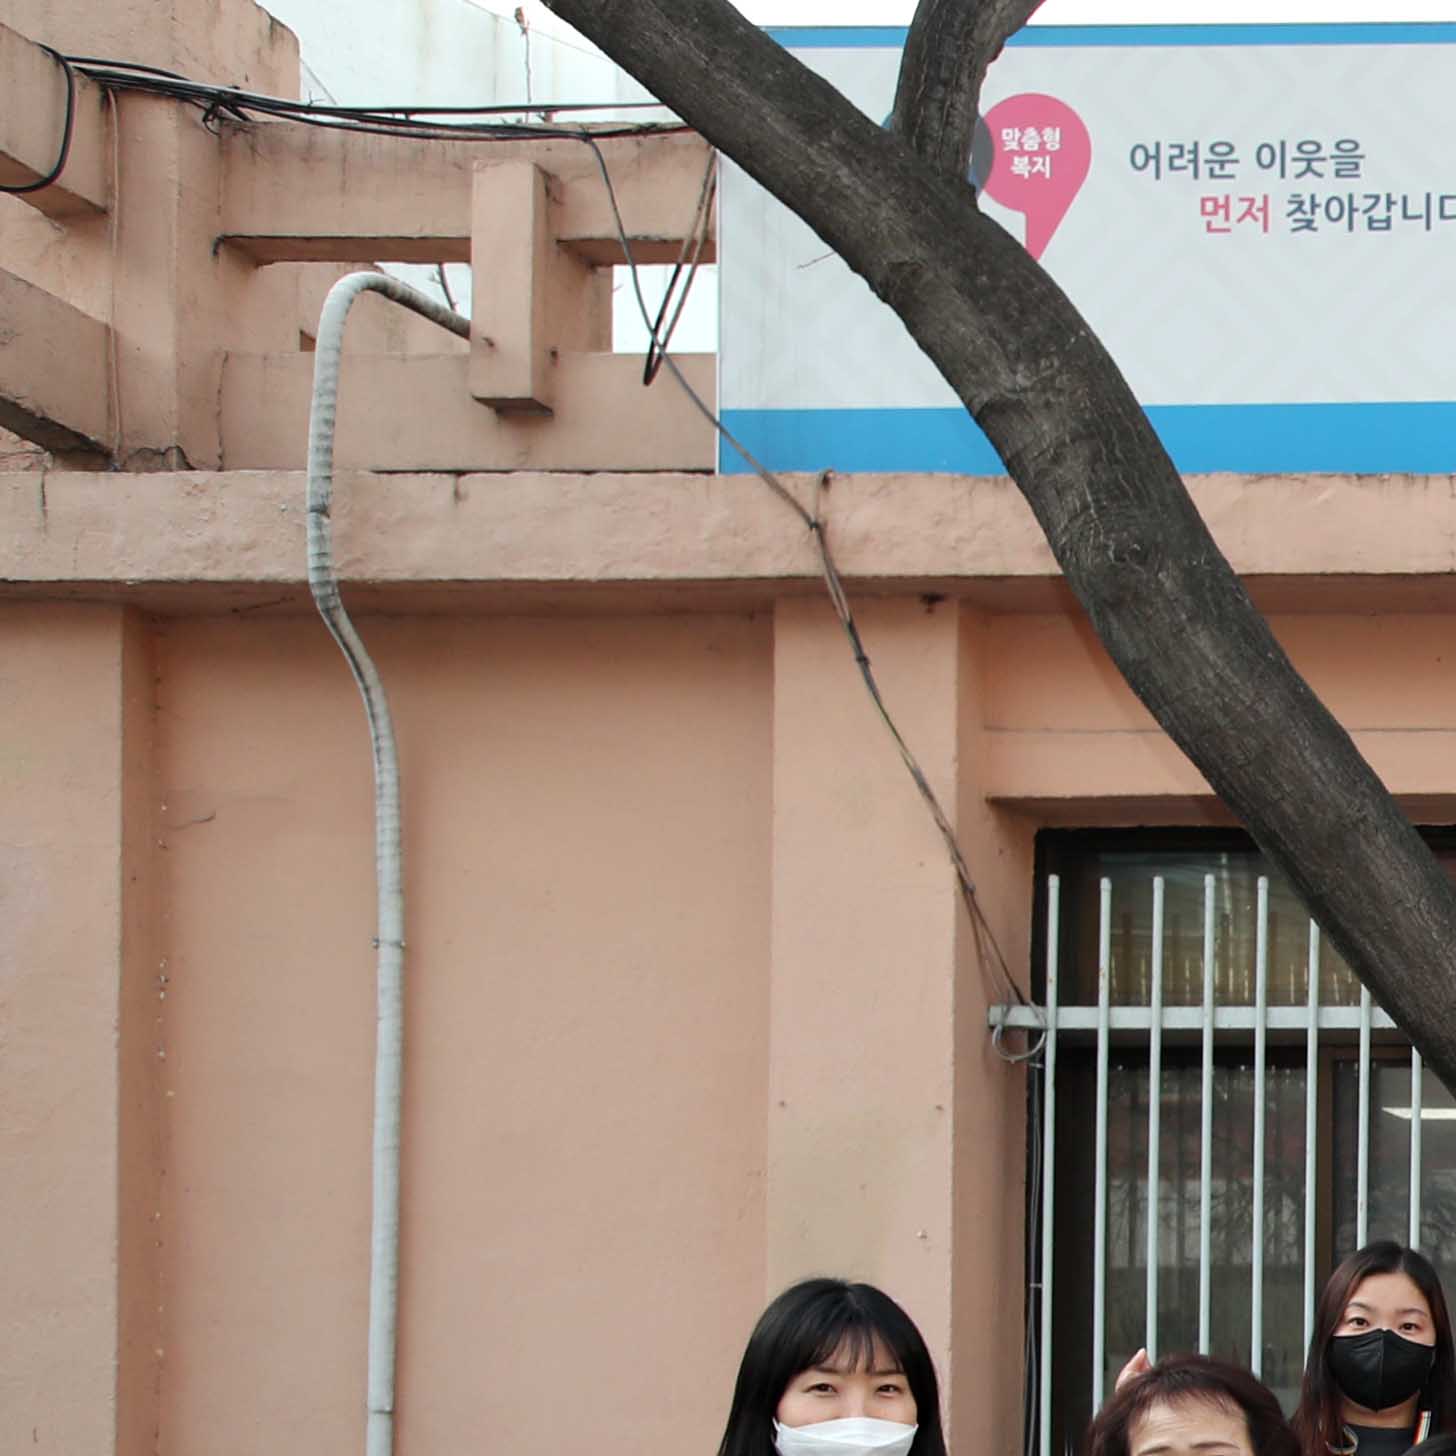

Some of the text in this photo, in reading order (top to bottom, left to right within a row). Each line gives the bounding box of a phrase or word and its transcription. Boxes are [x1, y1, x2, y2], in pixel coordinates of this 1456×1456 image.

[1001, 126, 1062, 153] 맞춤형
[1010, 155, 1052, 180] 복지
[1129, 137, 1366, 180] 어려운 이웃을
[1199, 193, 1271, 234] 먼저
